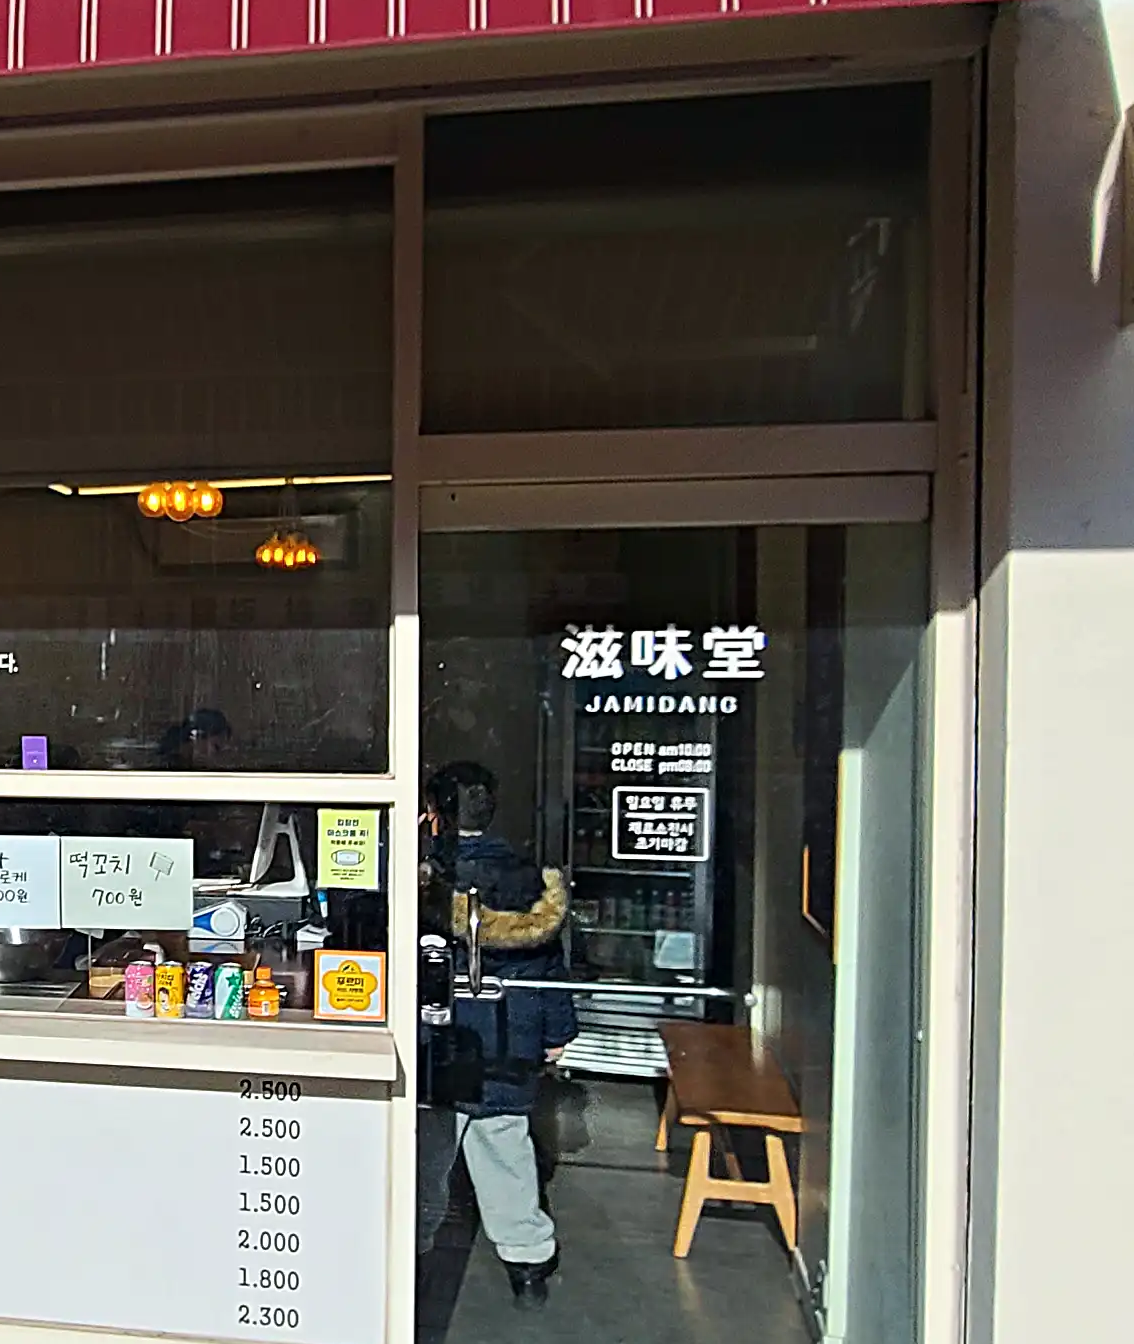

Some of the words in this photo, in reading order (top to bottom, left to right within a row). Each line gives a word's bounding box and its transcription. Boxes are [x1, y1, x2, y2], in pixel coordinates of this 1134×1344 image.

[560, 623, 766, 680] 滋味堂
[584, 695, 739, 714] JAMIDANG
[611, 742, 656, 756] OPEN
[611, 758, 654, 772] CLOSE
[69, 851, 130, 879] 떡꼬치
[91, 888, 143, 907] 700원
[239, 1078, 302, 1102] 2.500
[239, 1117, 301, 1141] 2.500
[239, 1154, 301, 1178] 1.500
[239, 1192, 301, 1216] 1.500
[237, 1230, 301, 1254] 2.000
[238, 1267, 300, 1291] 1.800
[238, 1305, 300, 1329] 2.300
